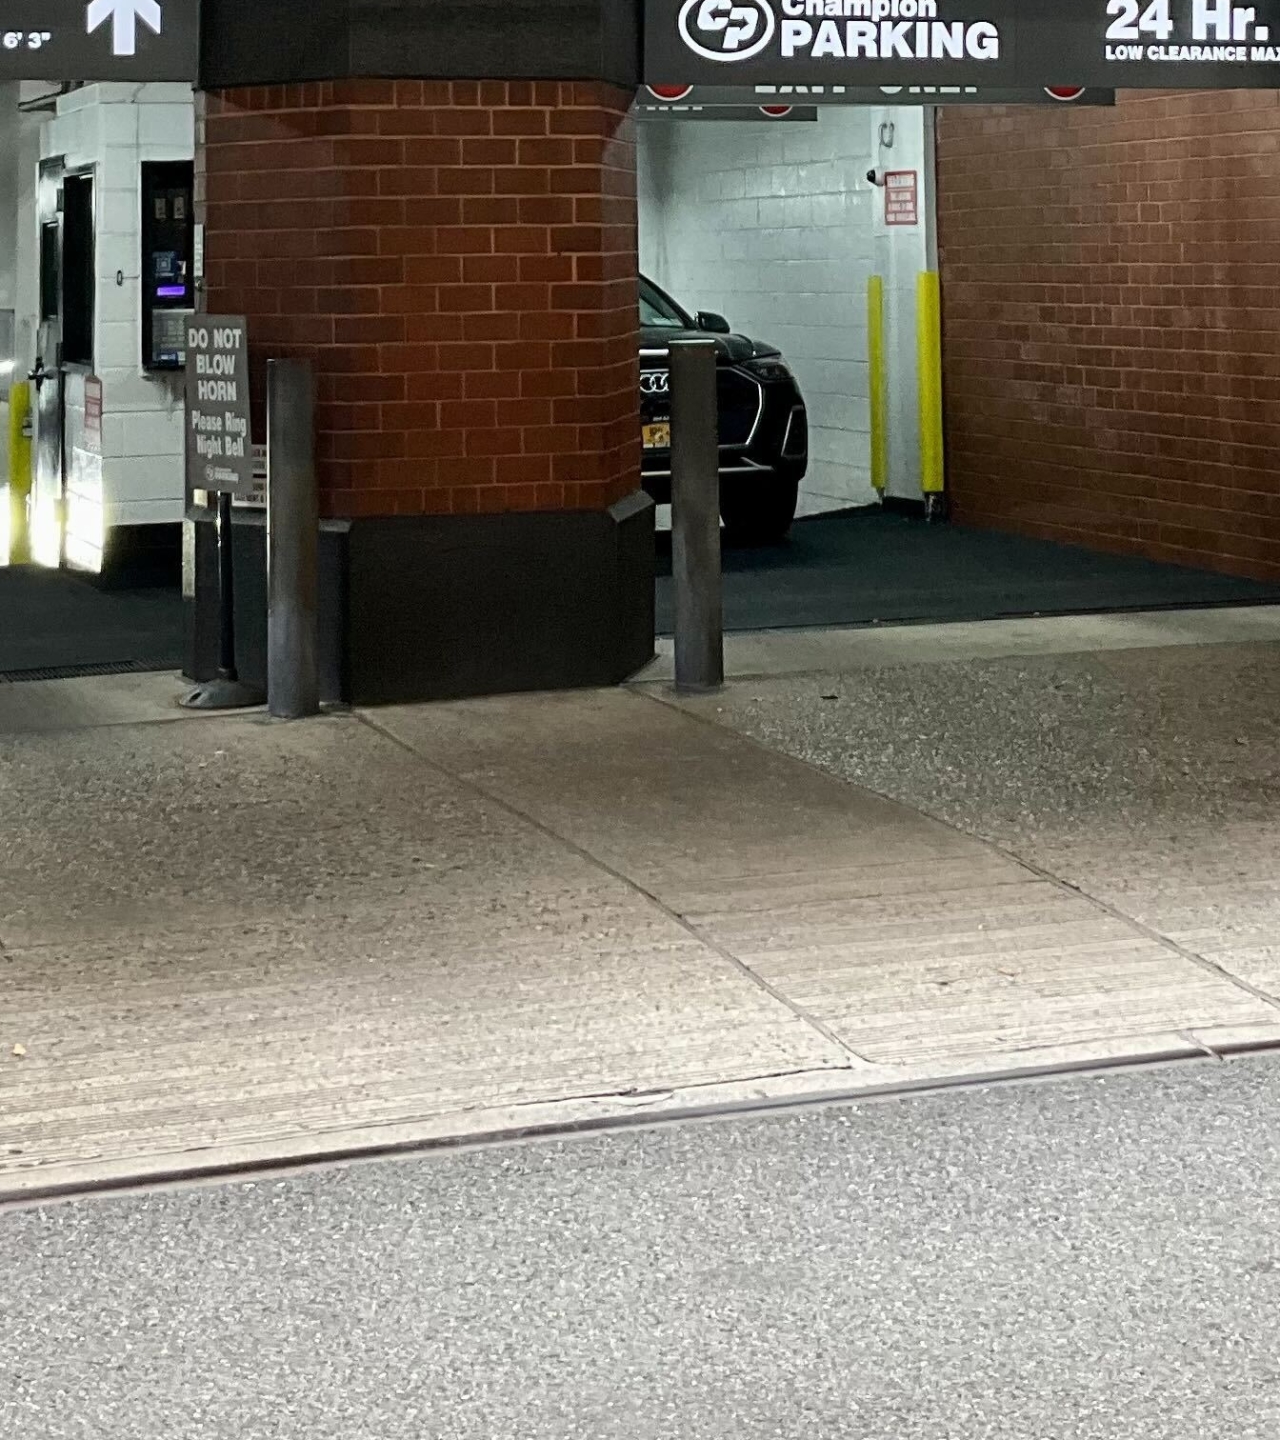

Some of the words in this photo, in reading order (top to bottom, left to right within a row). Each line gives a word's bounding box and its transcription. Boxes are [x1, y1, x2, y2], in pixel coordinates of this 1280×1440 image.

[3, 31, 23, 49] 6'
[781, 19, 999, 60] PARKING
[1105, 45, 1144, 60] LOW
[1147, 45, 1247, 61] CLEARANCE
[188, 328, 209, 349] DO
[213, 328, 242, 349] NOT
[196, 353, 235, 375] BLOW
[197, 380, 237, 401] HORN
[191, 410, 222, 432] Please
[225, 411, 247, 438] Ring
[196, 434, 222, 459] Night
[225, 435, 244, 458] Bell
